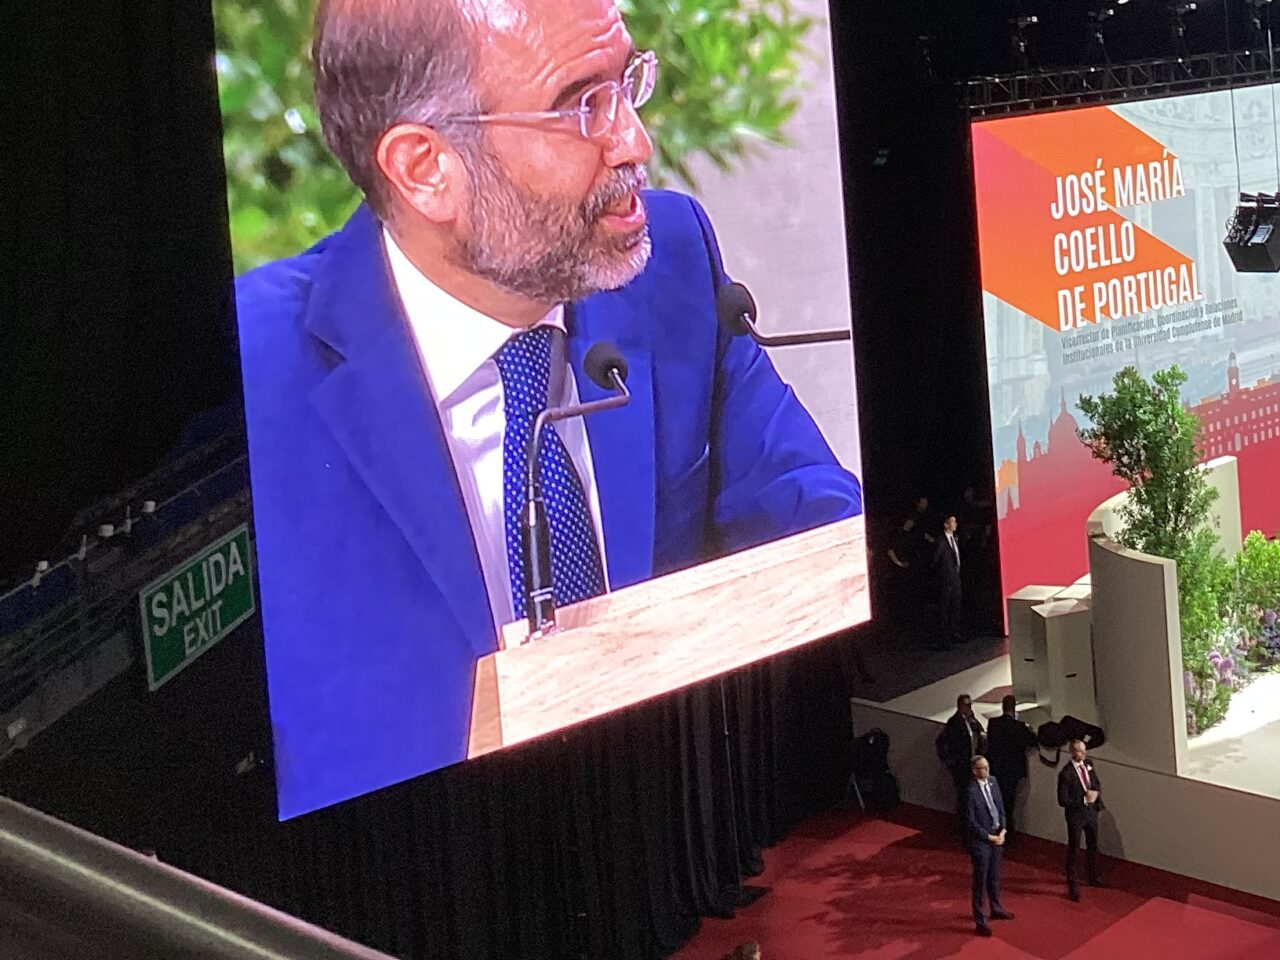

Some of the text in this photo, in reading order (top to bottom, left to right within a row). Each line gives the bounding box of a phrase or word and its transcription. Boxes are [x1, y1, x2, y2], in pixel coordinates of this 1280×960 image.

[1050, 148, 1186, 220] JOSÉ MARÍA
[1053, 220, 1136, 276] COELLO
[1057, 262, 1205, 332] DE PORTUGAL
[1101, 327, 1110, 340] de
[1115, 340, 1124, 352] de
[1125, 338, 1132, 350] la
[1132, 327, 1171, 348] Universidad
[1171, 319, 1212, 338] Complutense
[1213, 316, 1221, 328] de
[1222, 309, 1243, 325] Madrid
[151, 541, 245, 637] SALIDA
[183, 600, 223, 658] EXIT
